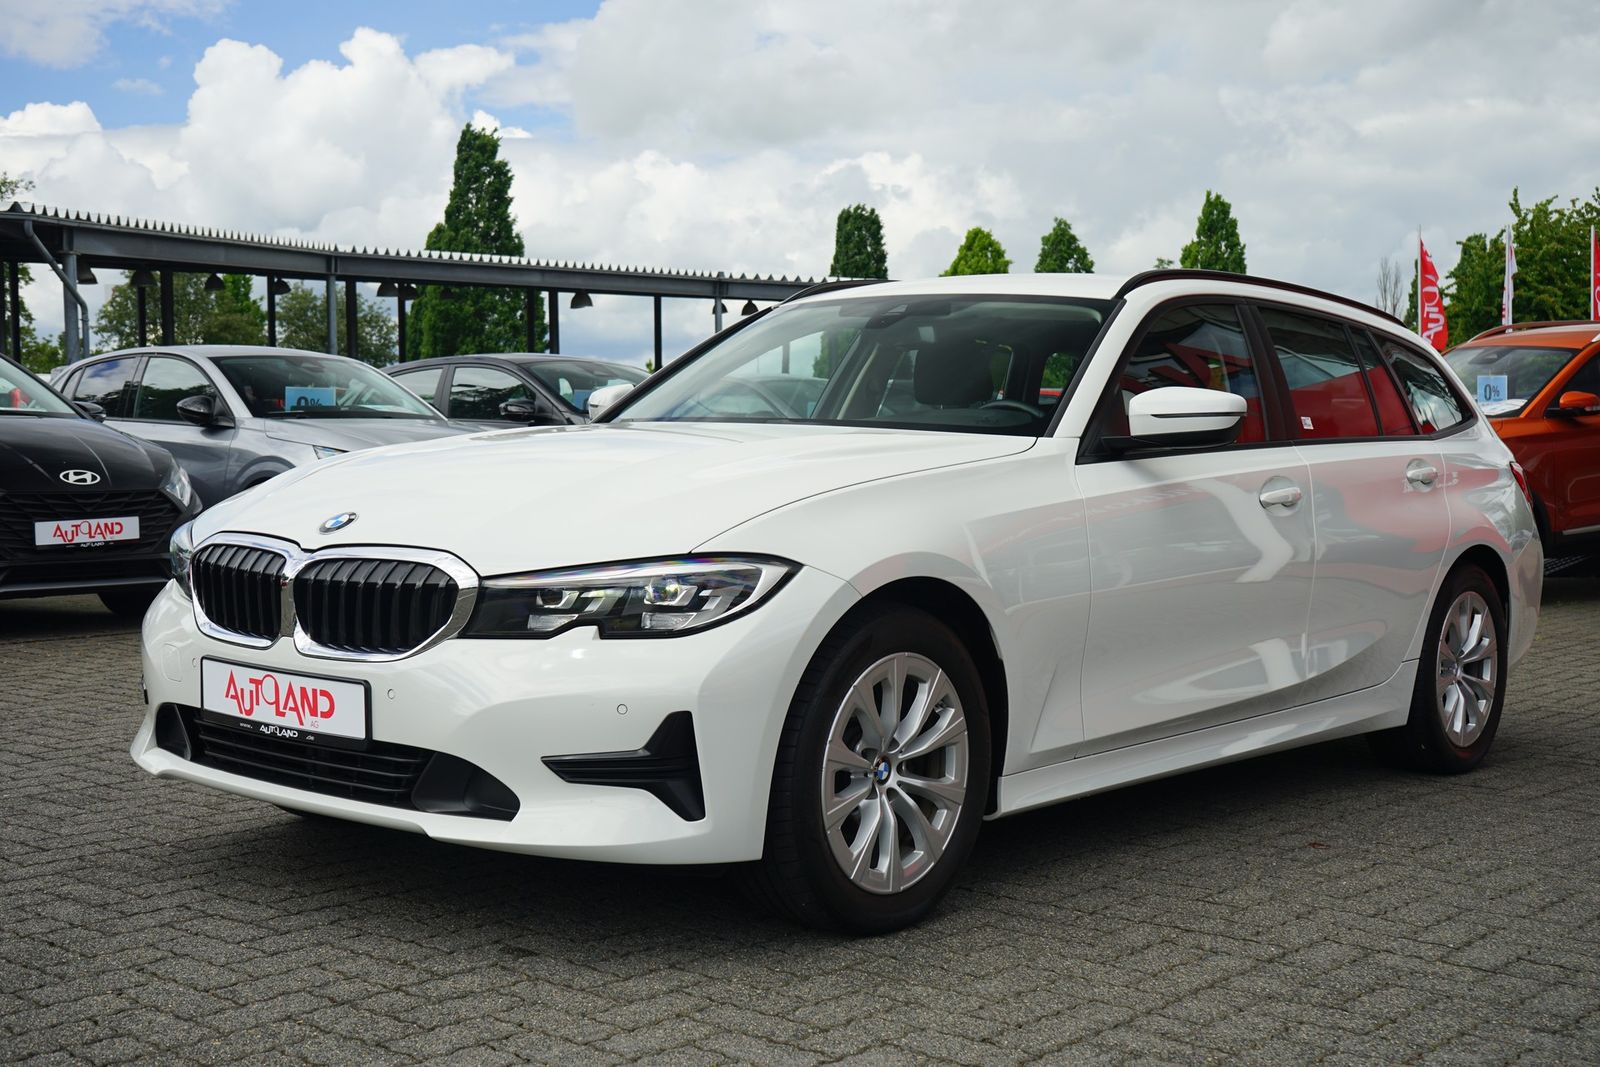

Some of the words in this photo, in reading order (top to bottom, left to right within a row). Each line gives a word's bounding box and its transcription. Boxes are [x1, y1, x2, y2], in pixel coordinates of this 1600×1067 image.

[1484, 383, 1500, 401] 0%
[53, 520, 124, 543] AUTOLAND
[224, 669, 336, 726] AUTOLAND
[259, 724, 299, 738] AUTOLAND
[310, 720, 320, 729] AG
